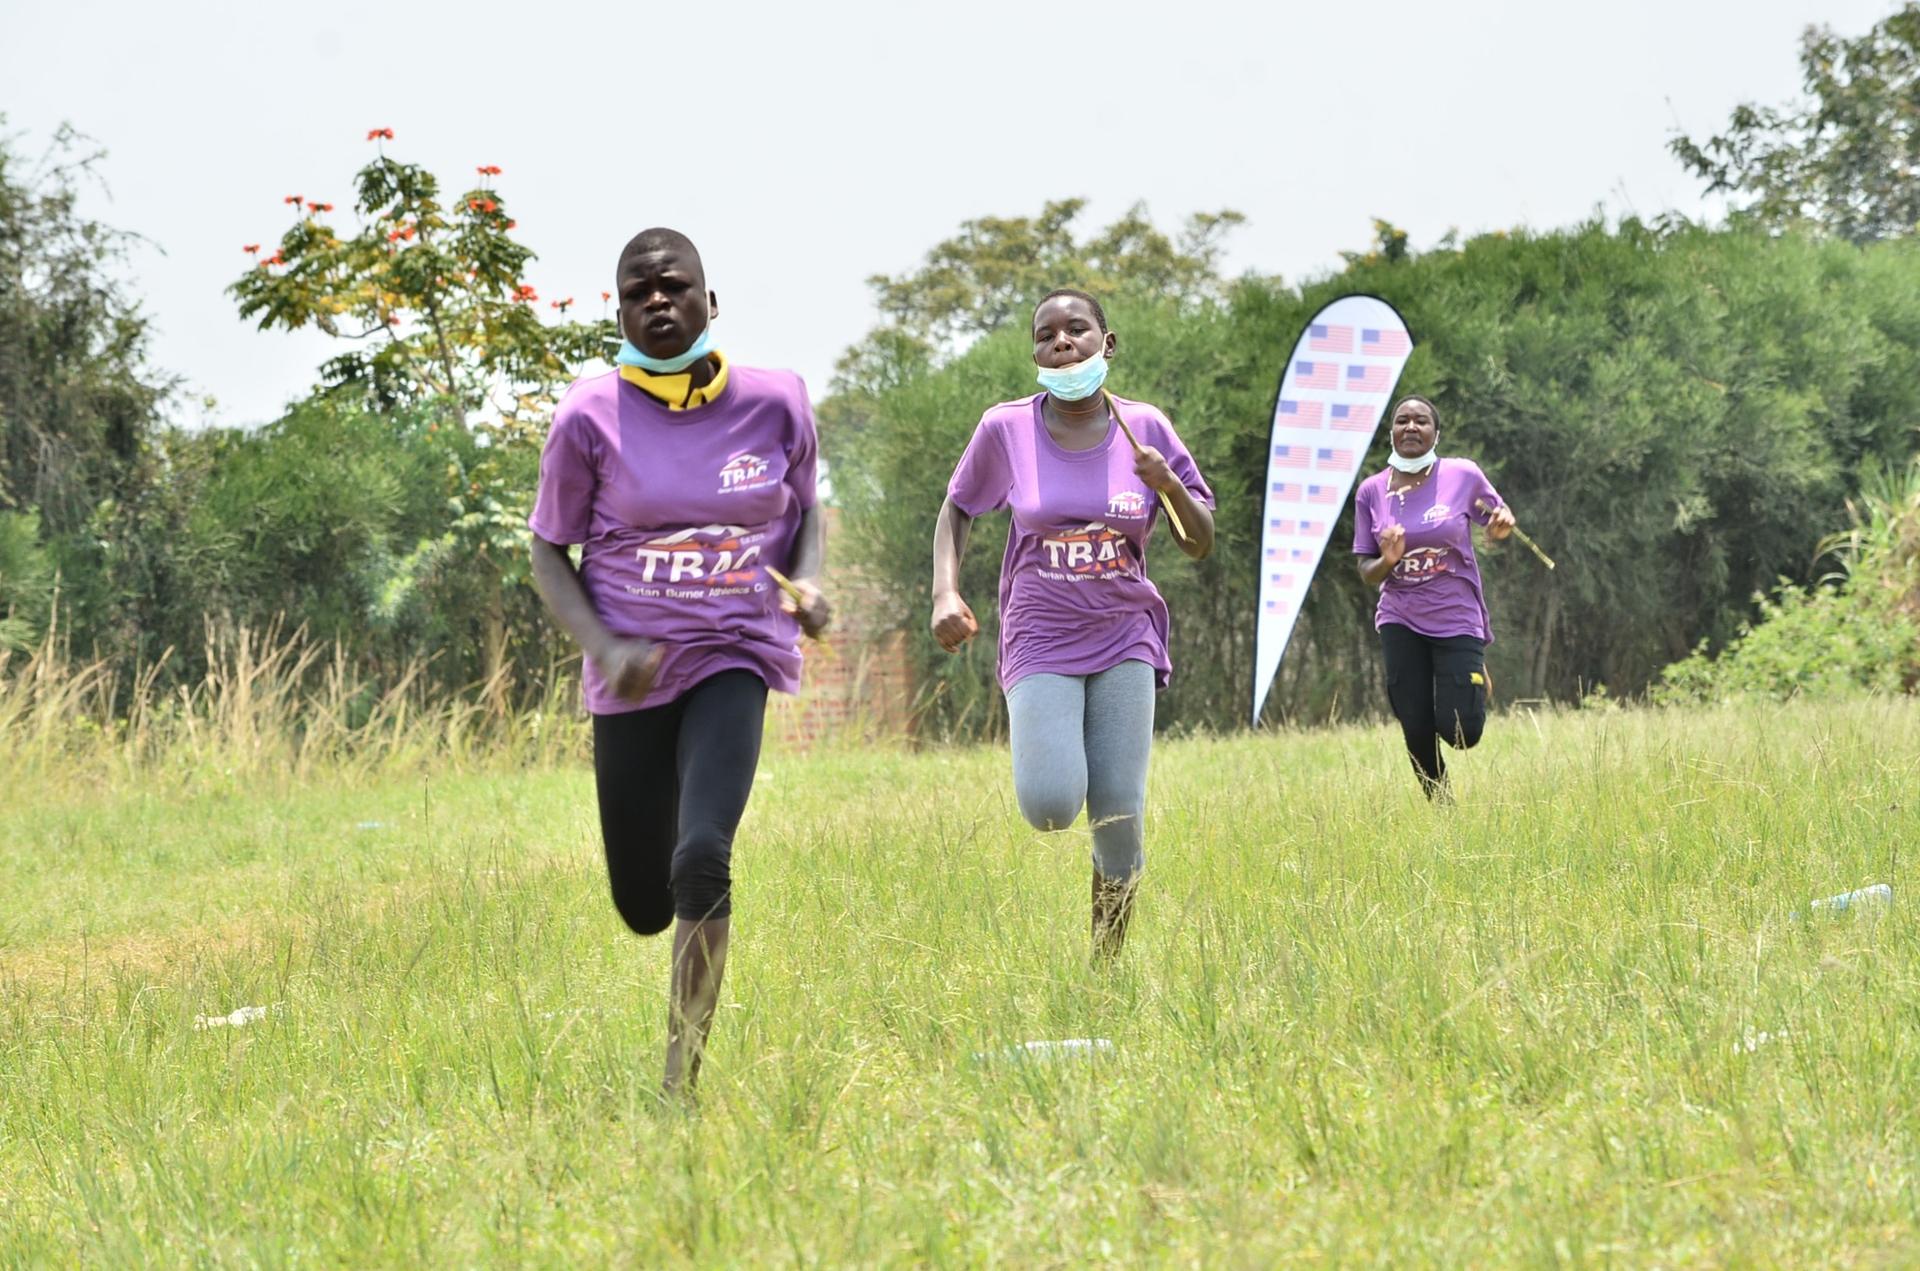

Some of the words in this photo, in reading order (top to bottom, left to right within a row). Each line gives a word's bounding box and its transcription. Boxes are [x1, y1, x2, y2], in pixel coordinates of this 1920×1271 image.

[719, 464, 768, 488] TRAC
[636, 545, 761, 583] TRAC
[624, 584, 661, 598] Tartan
[665, 587, 705, 599] Burner
